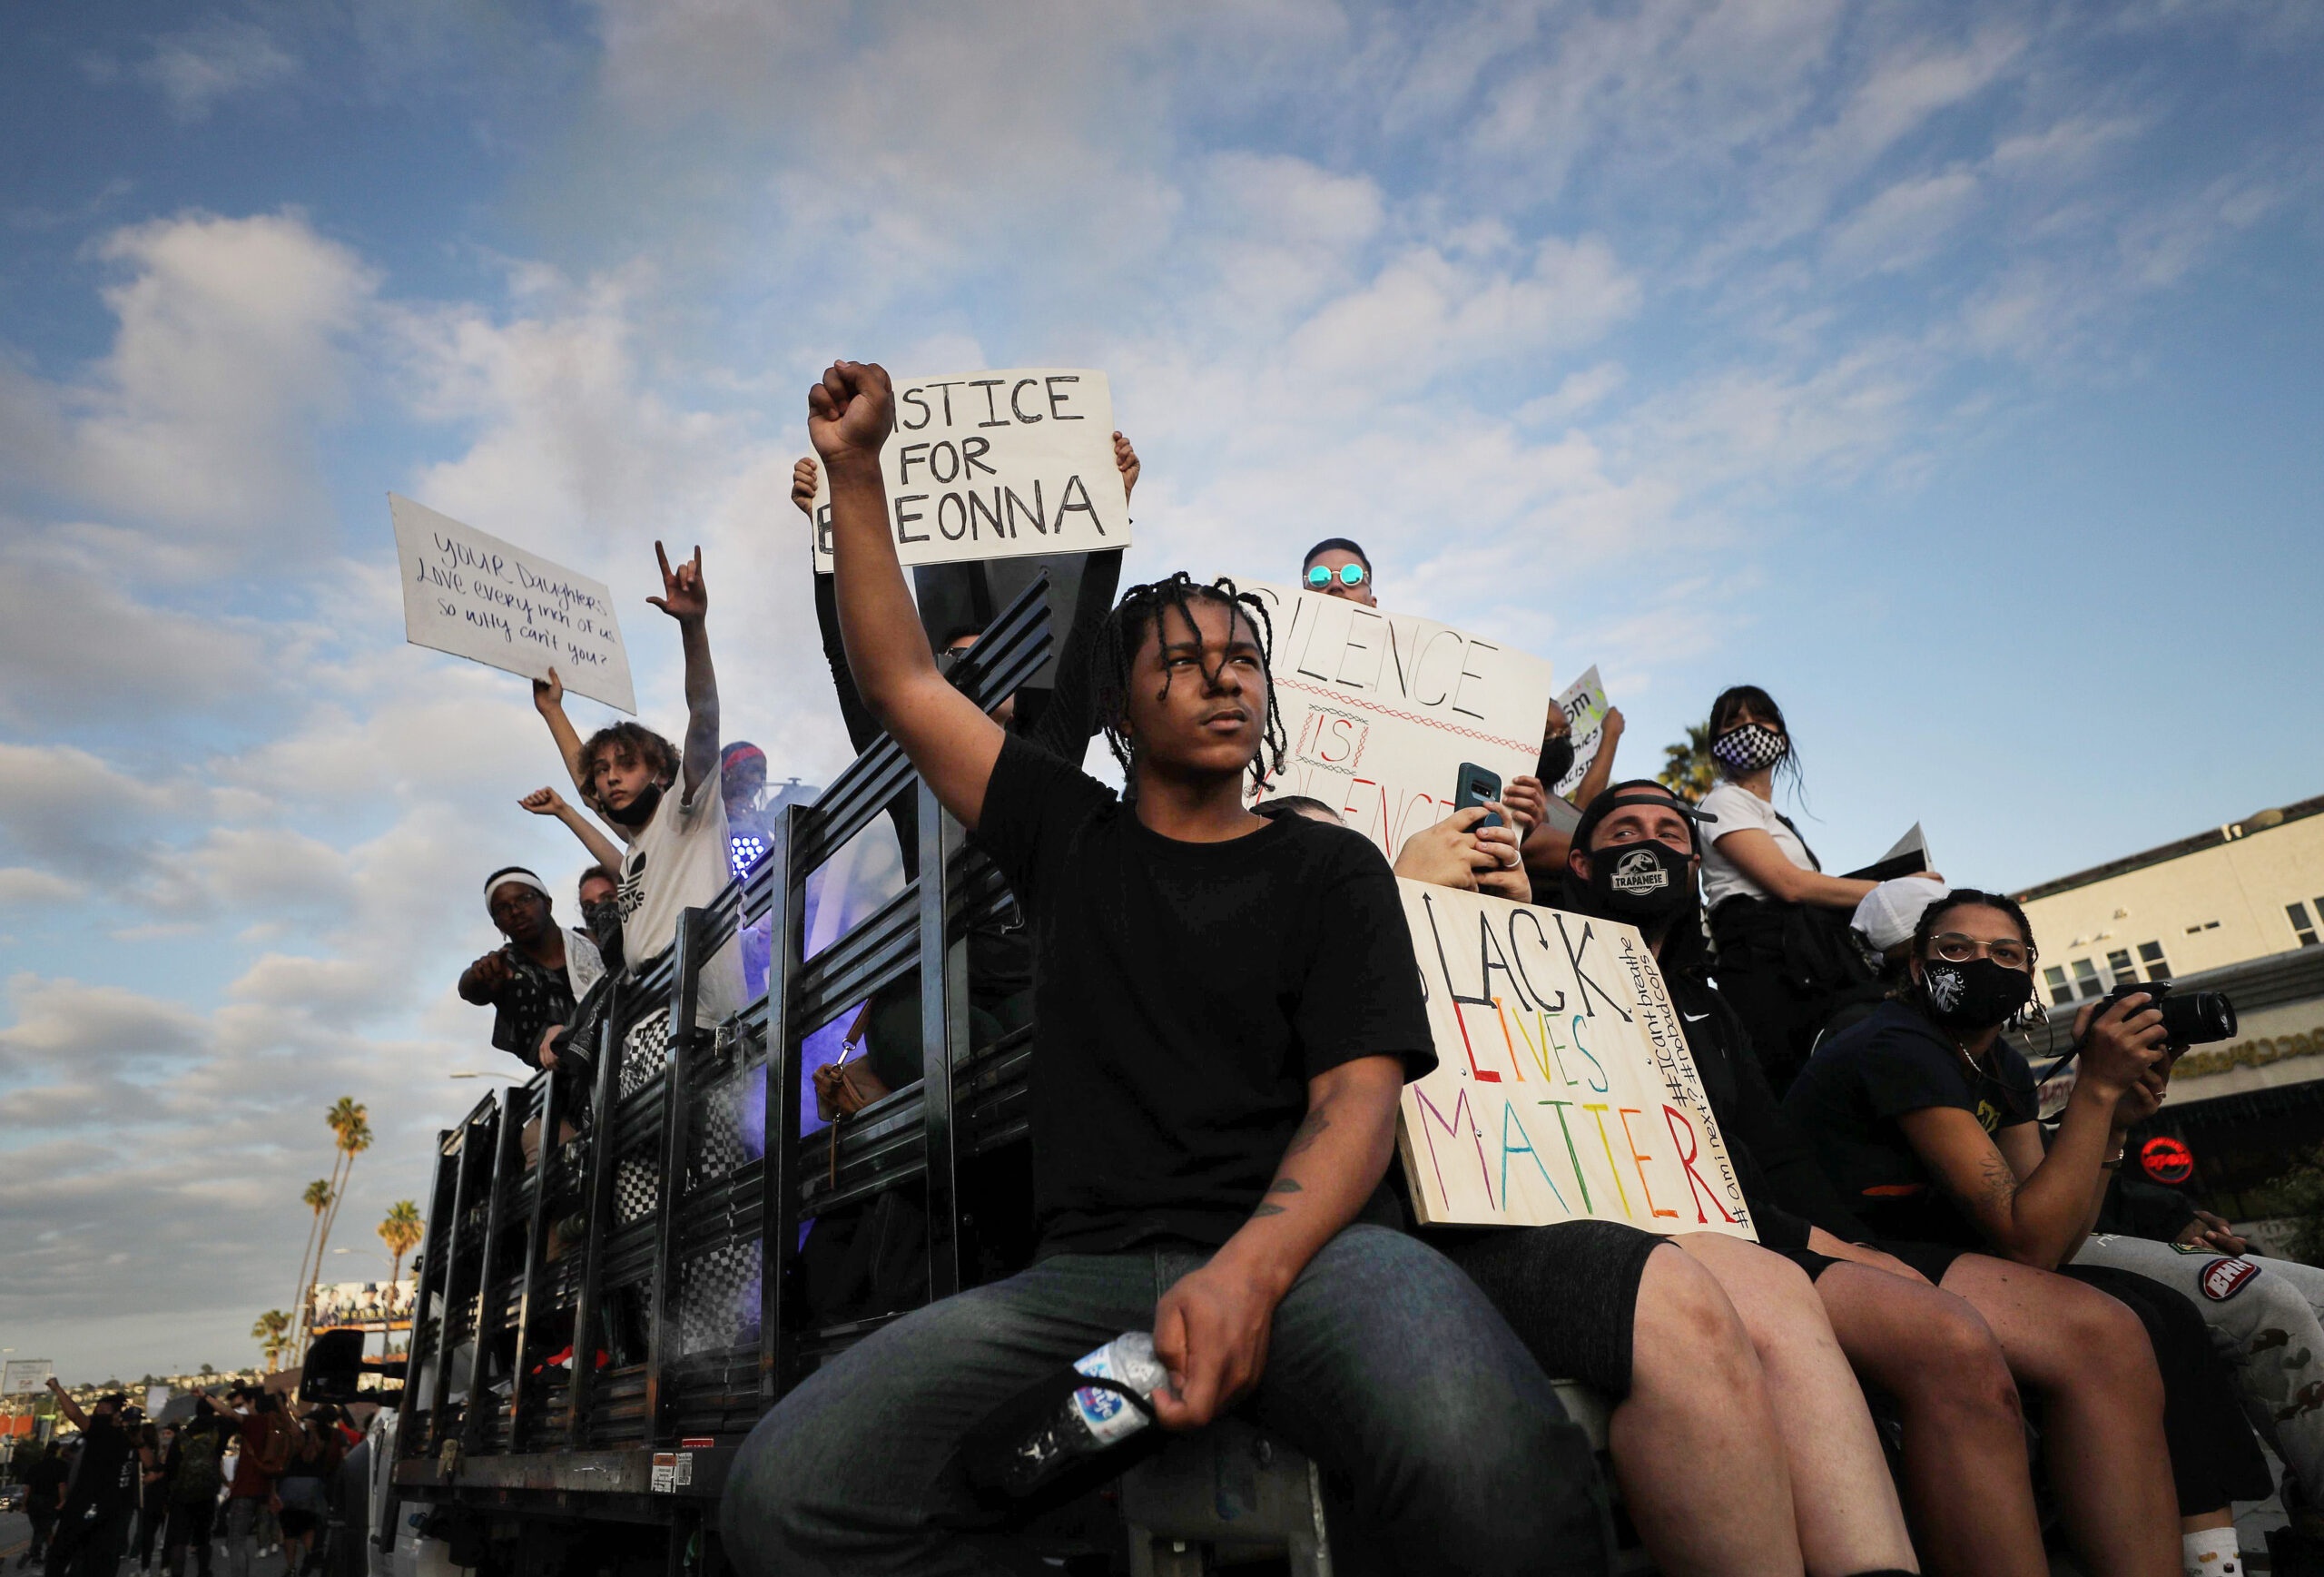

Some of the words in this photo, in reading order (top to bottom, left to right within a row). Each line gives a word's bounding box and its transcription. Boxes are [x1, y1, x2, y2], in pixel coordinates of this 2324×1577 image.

[891, 375, 1086, 433] STICE
[901, 437, 997, 486] FOR
[817, 475, 1106, 556] BEONNA
[1311, 715, 1352, 762] IS
[1615, 873, 1663, 887] TRAPANESE
[1416, 892, 1632, 1022] LACK
[1453, 997, 1608, 1092] LIVES
[1413, 1083, 1738, 1224] MATTER
[2207, 1259, 2252, 1297] BHM
